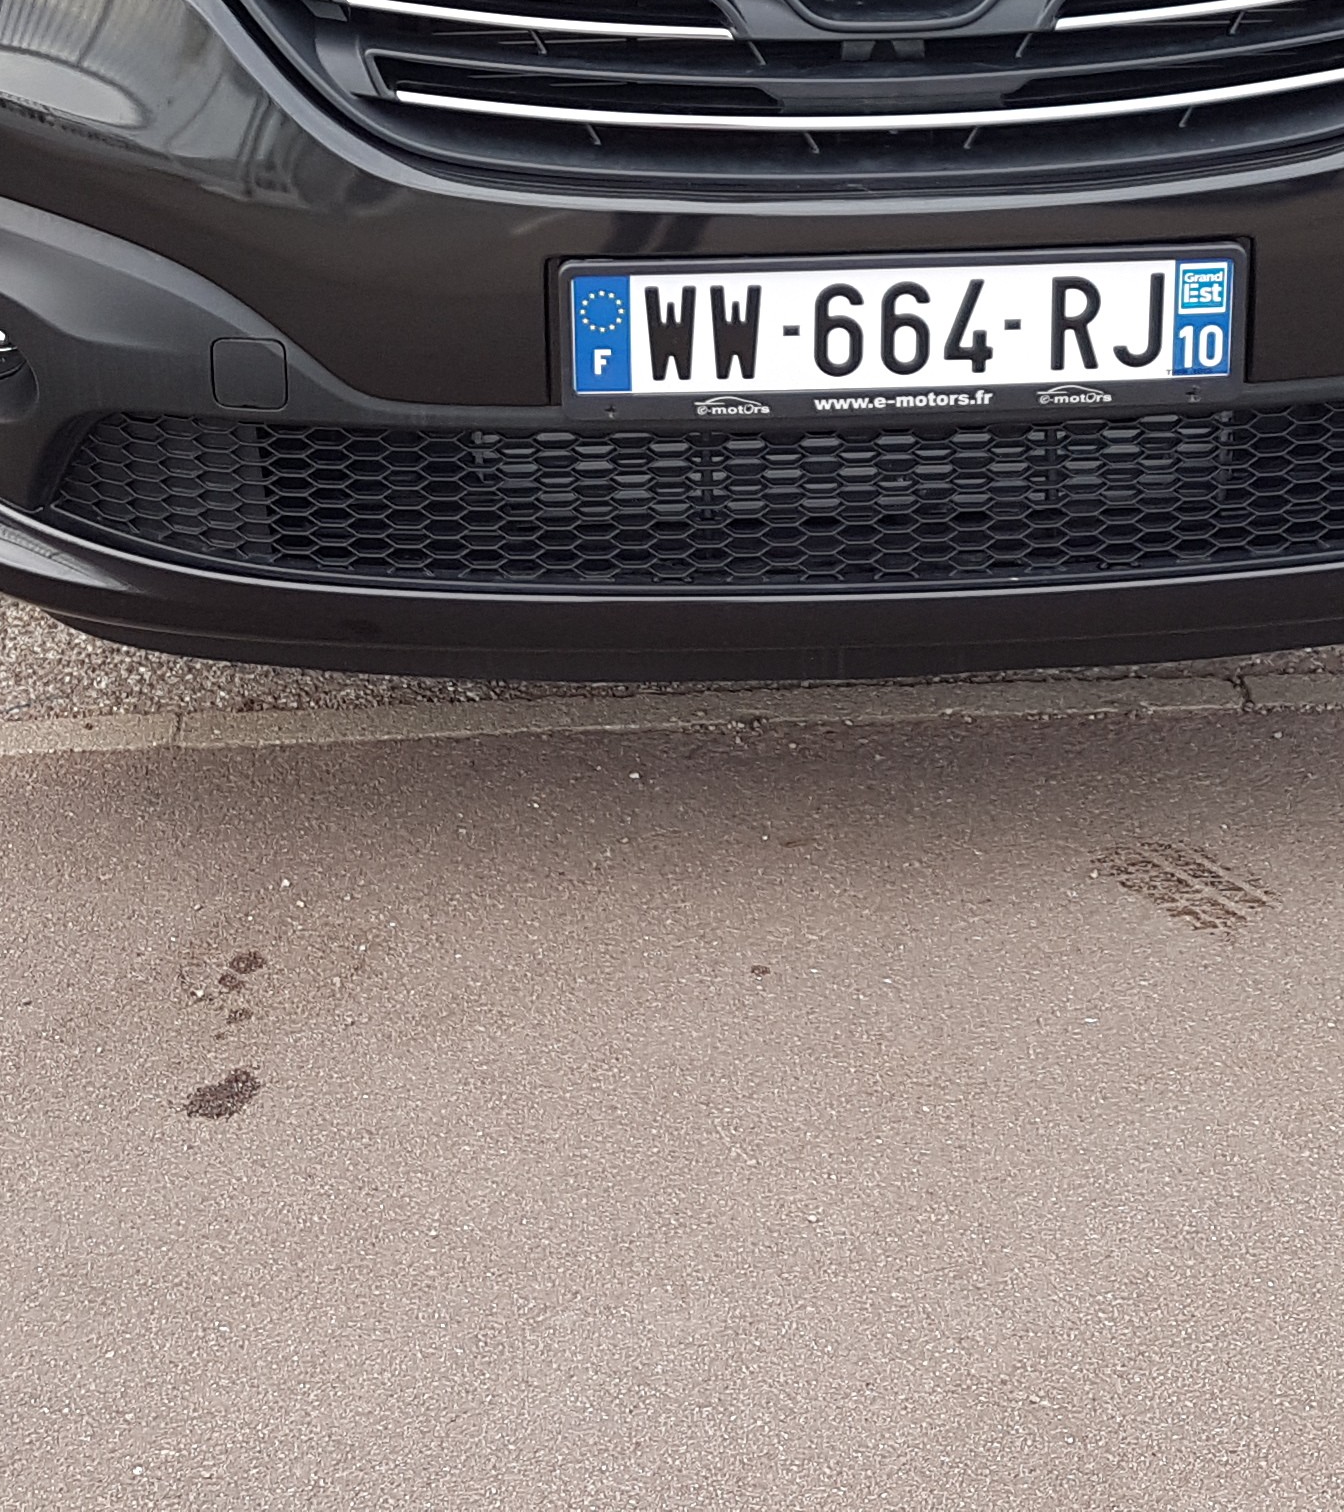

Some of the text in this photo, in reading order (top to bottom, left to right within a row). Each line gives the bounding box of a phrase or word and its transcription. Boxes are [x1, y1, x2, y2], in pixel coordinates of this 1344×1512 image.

[1184, 271, 1223, 283] Grand
[1183, 283, 1222, 303] Est
[1179, 324, 1224, 369] 10
[593, 348, 612, 375] F
[814, 390, 994, 410] www.e-motors.fr
